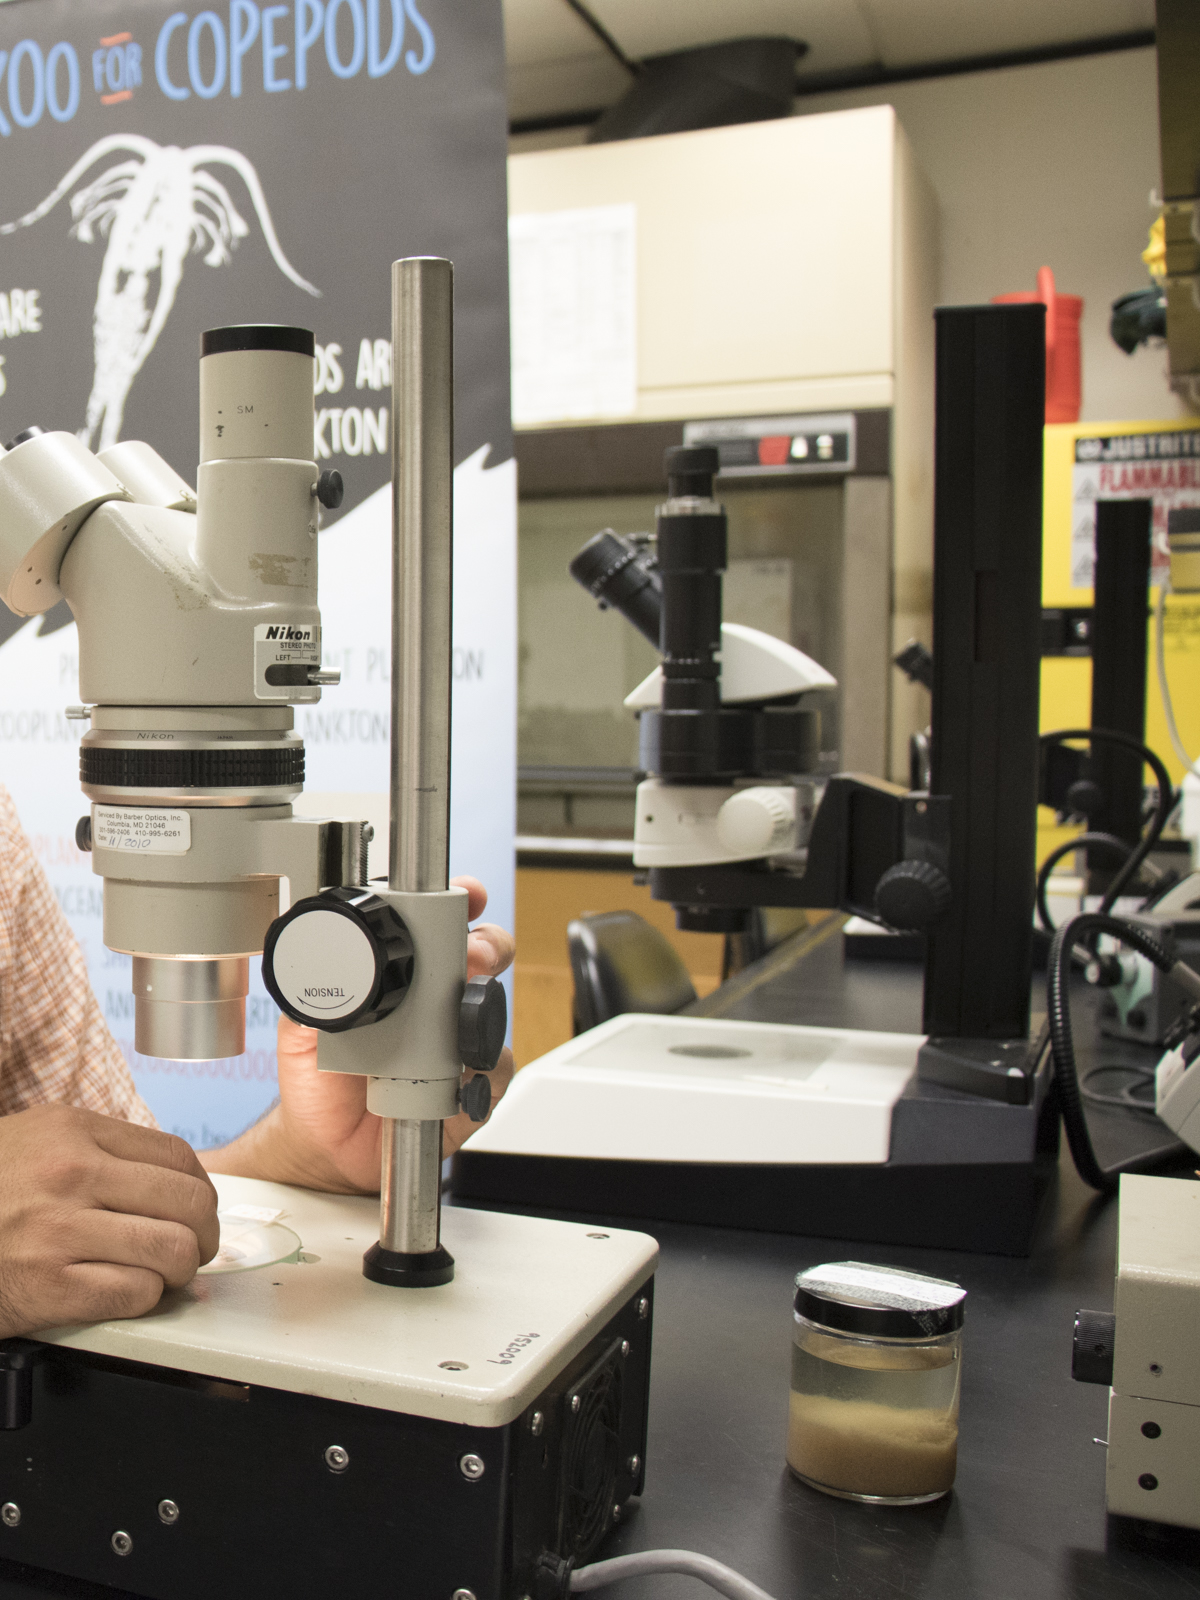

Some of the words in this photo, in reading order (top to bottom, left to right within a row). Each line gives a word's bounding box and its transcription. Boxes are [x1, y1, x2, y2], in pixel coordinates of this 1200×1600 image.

[92, 42, 142, 92] FOR
[155, 0, 436, 100] COPEPODS
[237, 405, 254, 414] SM
[265, 625, 310, 641] Nikon
[136, 732, 174, 740] Nikon
[98, 811, 115, 819] Serviced
[107, 820, 131, 828] Columbia,
[304, 988, 345, 997] TENSION
